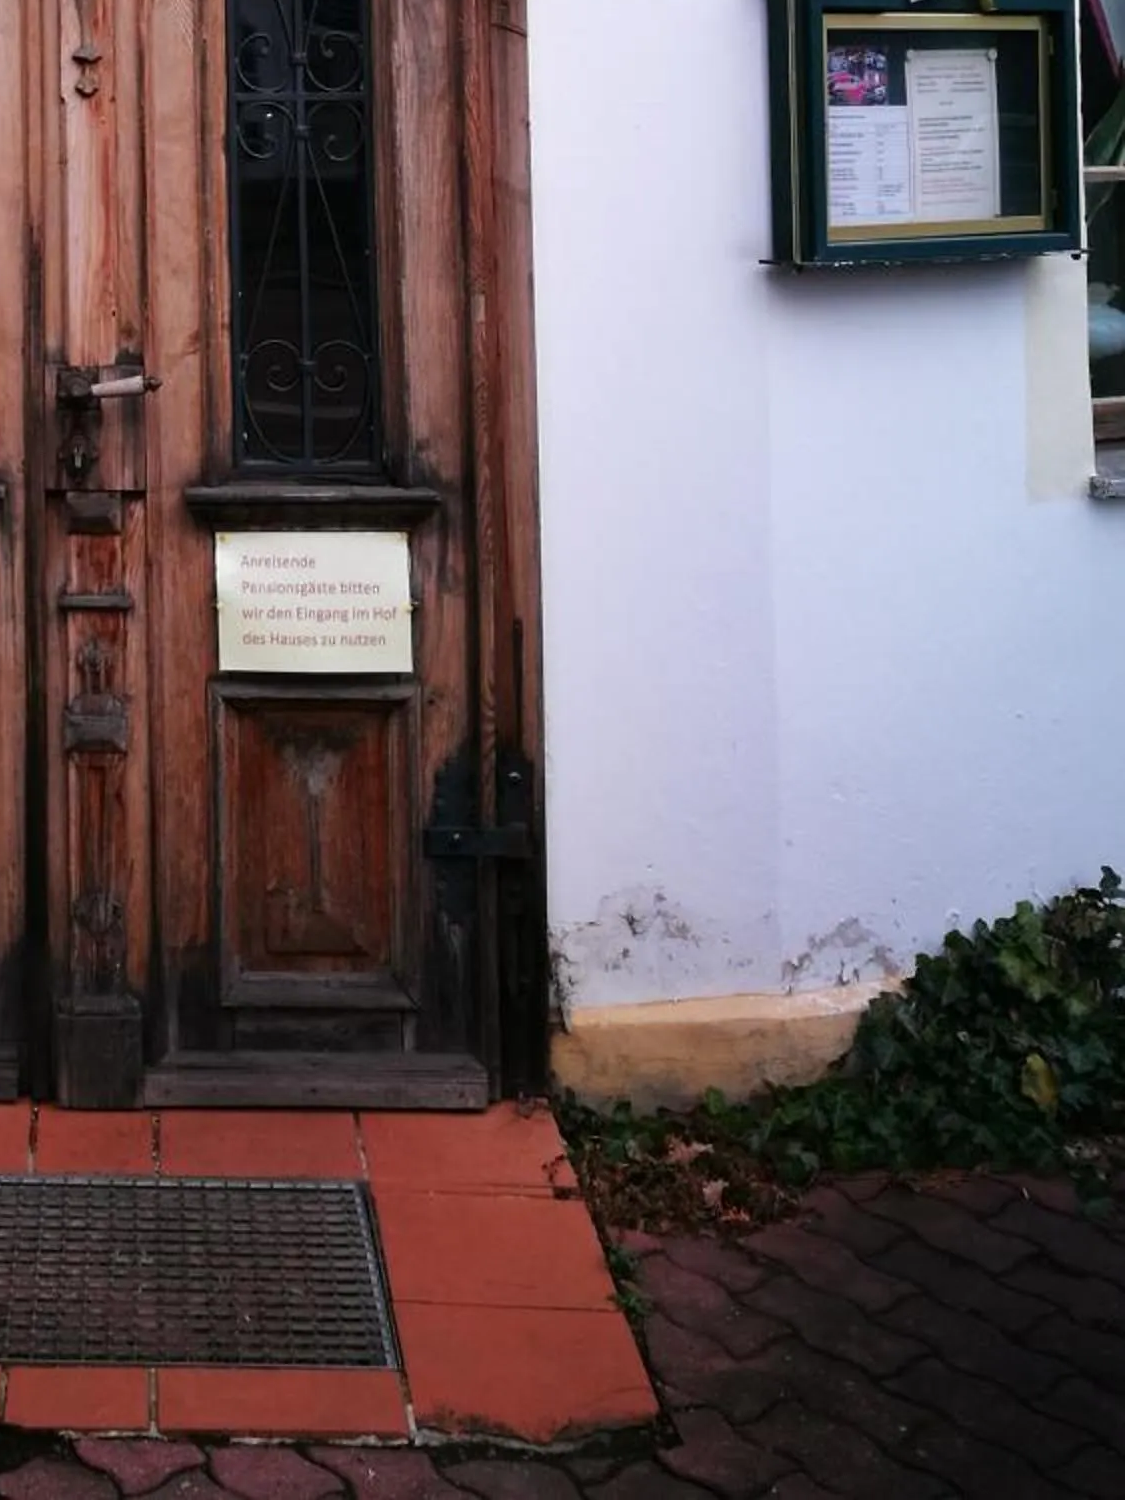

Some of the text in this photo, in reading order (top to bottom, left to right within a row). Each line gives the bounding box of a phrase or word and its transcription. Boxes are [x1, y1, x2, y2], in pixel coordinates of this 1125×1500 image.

[241, 555, 316, 568] Anreisende
[242, 580, 381, 597] Pensionsgäste bitten
[242, 606, 397, 623] wir den Eingang im Hof
[242, 631, 386, 646] des Hauses zu nutzen
